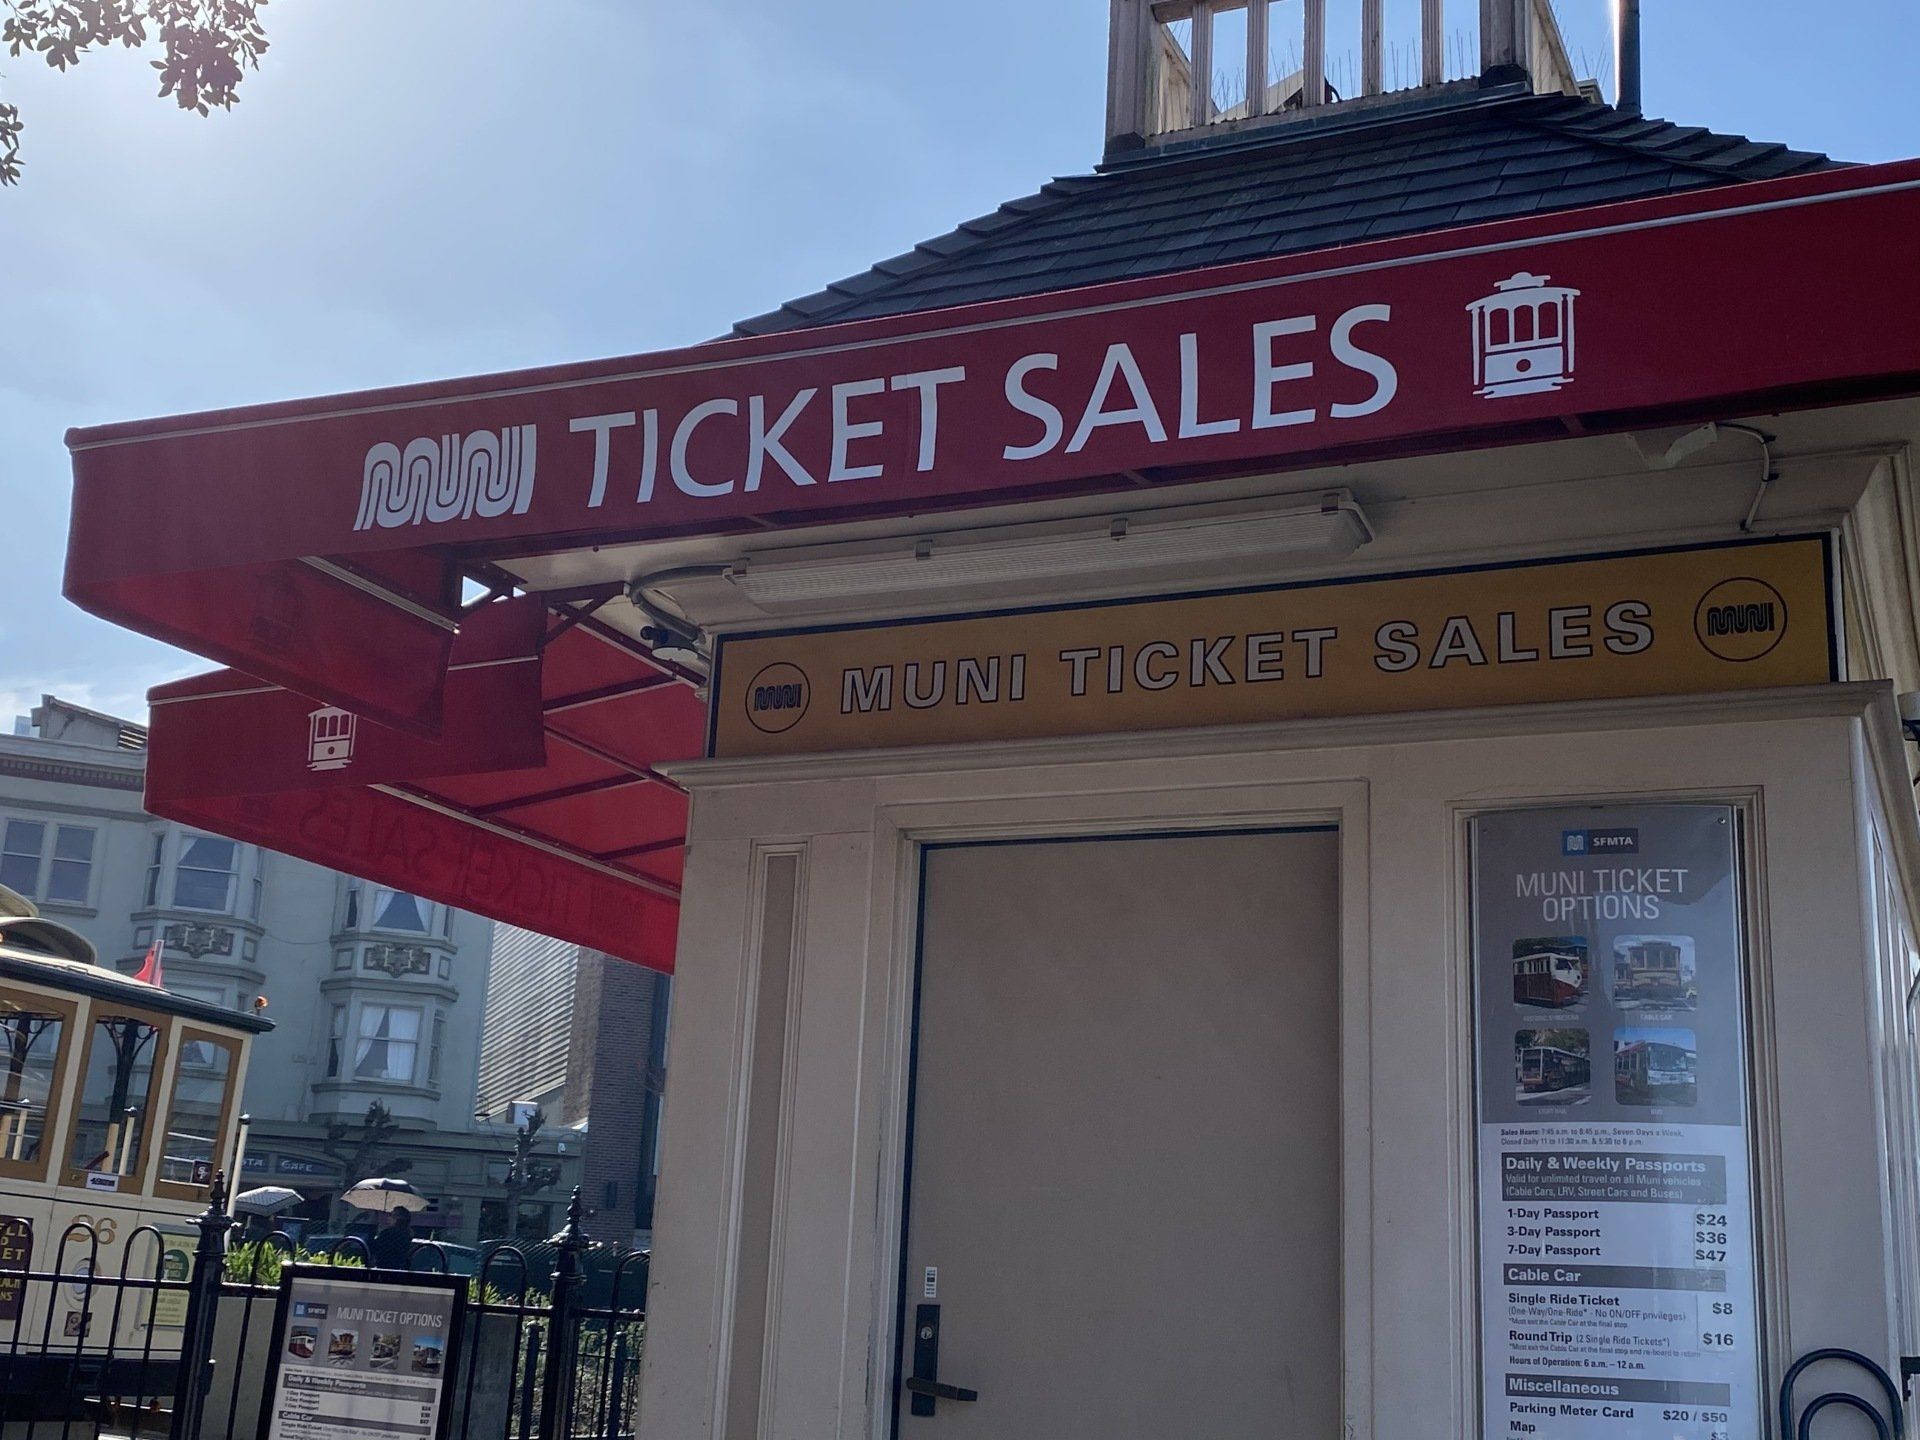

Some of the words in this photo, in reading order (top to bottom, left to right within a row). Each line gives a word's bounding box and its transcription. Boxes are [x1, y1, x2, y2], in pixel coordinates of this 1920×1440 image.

[353, 423, 537, 532] MUNI
[569, 365, 966, 509] TICKET
[1002, 303, 1399, 461] SALES
[840, 653, 1026, 714] MUNI
[1059, 626, 1338, 696] TICKET
[1374, 600, 1655, 672] SALES
[1592, 836, 1634, 847] SFMTA
[1516, 870, 1584, 898] MUNI
[1593, 868, 1688, 894] TICKET
[1542, 894, 1660, 922] OPTIONS
[1500, 1128, 1518, 1136] Sales
[1613, 1128, 1634, 1136] Seven
[1636, 1128, 1654, 1137] Days
[1523, 1138, 1539, 1146] Daily
[1506, 1157, 1542, 1172] Daily
[1548, 1156, 1560, 1170] &
[1562, 1157, 1620, 1172] Weekly
[1625, 1157, 1706, 1174] Passports
[1506, 1174, 1526, 1184] Valid
[1528, 1174, 1540, 1184] for
[1542, 1174, 1580, 1184] unlimited
[1582, 1174, 1607, 1184] travel
[1610, 1176, 1621, 1184] on
[1624, 1174, 1634, 1184] all
[1636, 1174, 1660, 1185] Muni
[1662, 1176, 1702, 1186] vehicles
[1506, 1186, 1532, 1197] (Cable
[1534, 1186, 1556, 1197] Cars,
[1578, 1186, 1606, 1197] Street
[1608, 1187, 1629, 1197] Cars
[1630, 1188, 1648, 1198] and
[1650, 1188, 1682, 1199] Buses)
[1507, 1208, 1540, 1220] 1-Day
[1544, 1208, 1599, 1220] Passport
[1696, 1213, 1728, 1227] $24
[1507, 1226, 1541, 1238] 3-Day
[1545, 1227, 1601, 1239] Passport
[1696, 1231, 1727, 1245] $36
[1507, 1244, 1541, 1256] 7-Day
[1545, 1244, 1601, 1257] Passport
[1695, 1249, 1726, 1263] $47
[1508, 1268, 1550, 1282] Cable
[1554, 1269, 1581, 1282] Car
[1508, 1292, 1546, 1306] Single
[1550, 1294, 1578, 1305] Ride
[1578, 1294, 1620, 1306] Ticket
[1712, 1301, 1733, 1315] $8
[336, 1306, 364, 1321] MUNI
[365, 1309, 401, 1324] TICKET
[400, 1312, 443, 1328] OPTIONS
[1595, 1309, 1608, 1318] No
[1610, 1310, 1640, 1319] ON/OFF
[1642, 1311, 1686, 1322] privileges)
[1509, 1330, 1548, 1341] Round
[1549, 1332, 1572, 1344] Trip
[1576, 1334, 1584, 1344] (2
[1586, 1334, 1610, 1346] Single
[1612, 1336, 1631, 1344] Ride
[1702, 1332, 1734, 1346] $16
[1510, 1356, 1532, 1365] Hours
[1533, 1356, 1540, 1365] of
[1542, 1356, 1582, 1367] Operation:
[1584, 1358, 1590, 1367] 6
[1590, 1360, 1608, 1368] a.m.
[1617, 1360, 1626, 1368] 12
[1628, 1362, 1646, 1370] a.m.
[1509, 1378, 1620, 1396] Miscellaneous
[1510, 1402, 1556, 1416] Parking
[1560, 1404, 1598, 1416] Meter
[1602, 1406, 1634, 1418] Card
[1662, 1410, 1689, 1422] $20
[1702, 1412, 1728, 1423] $50
[1510, 1420, 1536, 1434] Map
